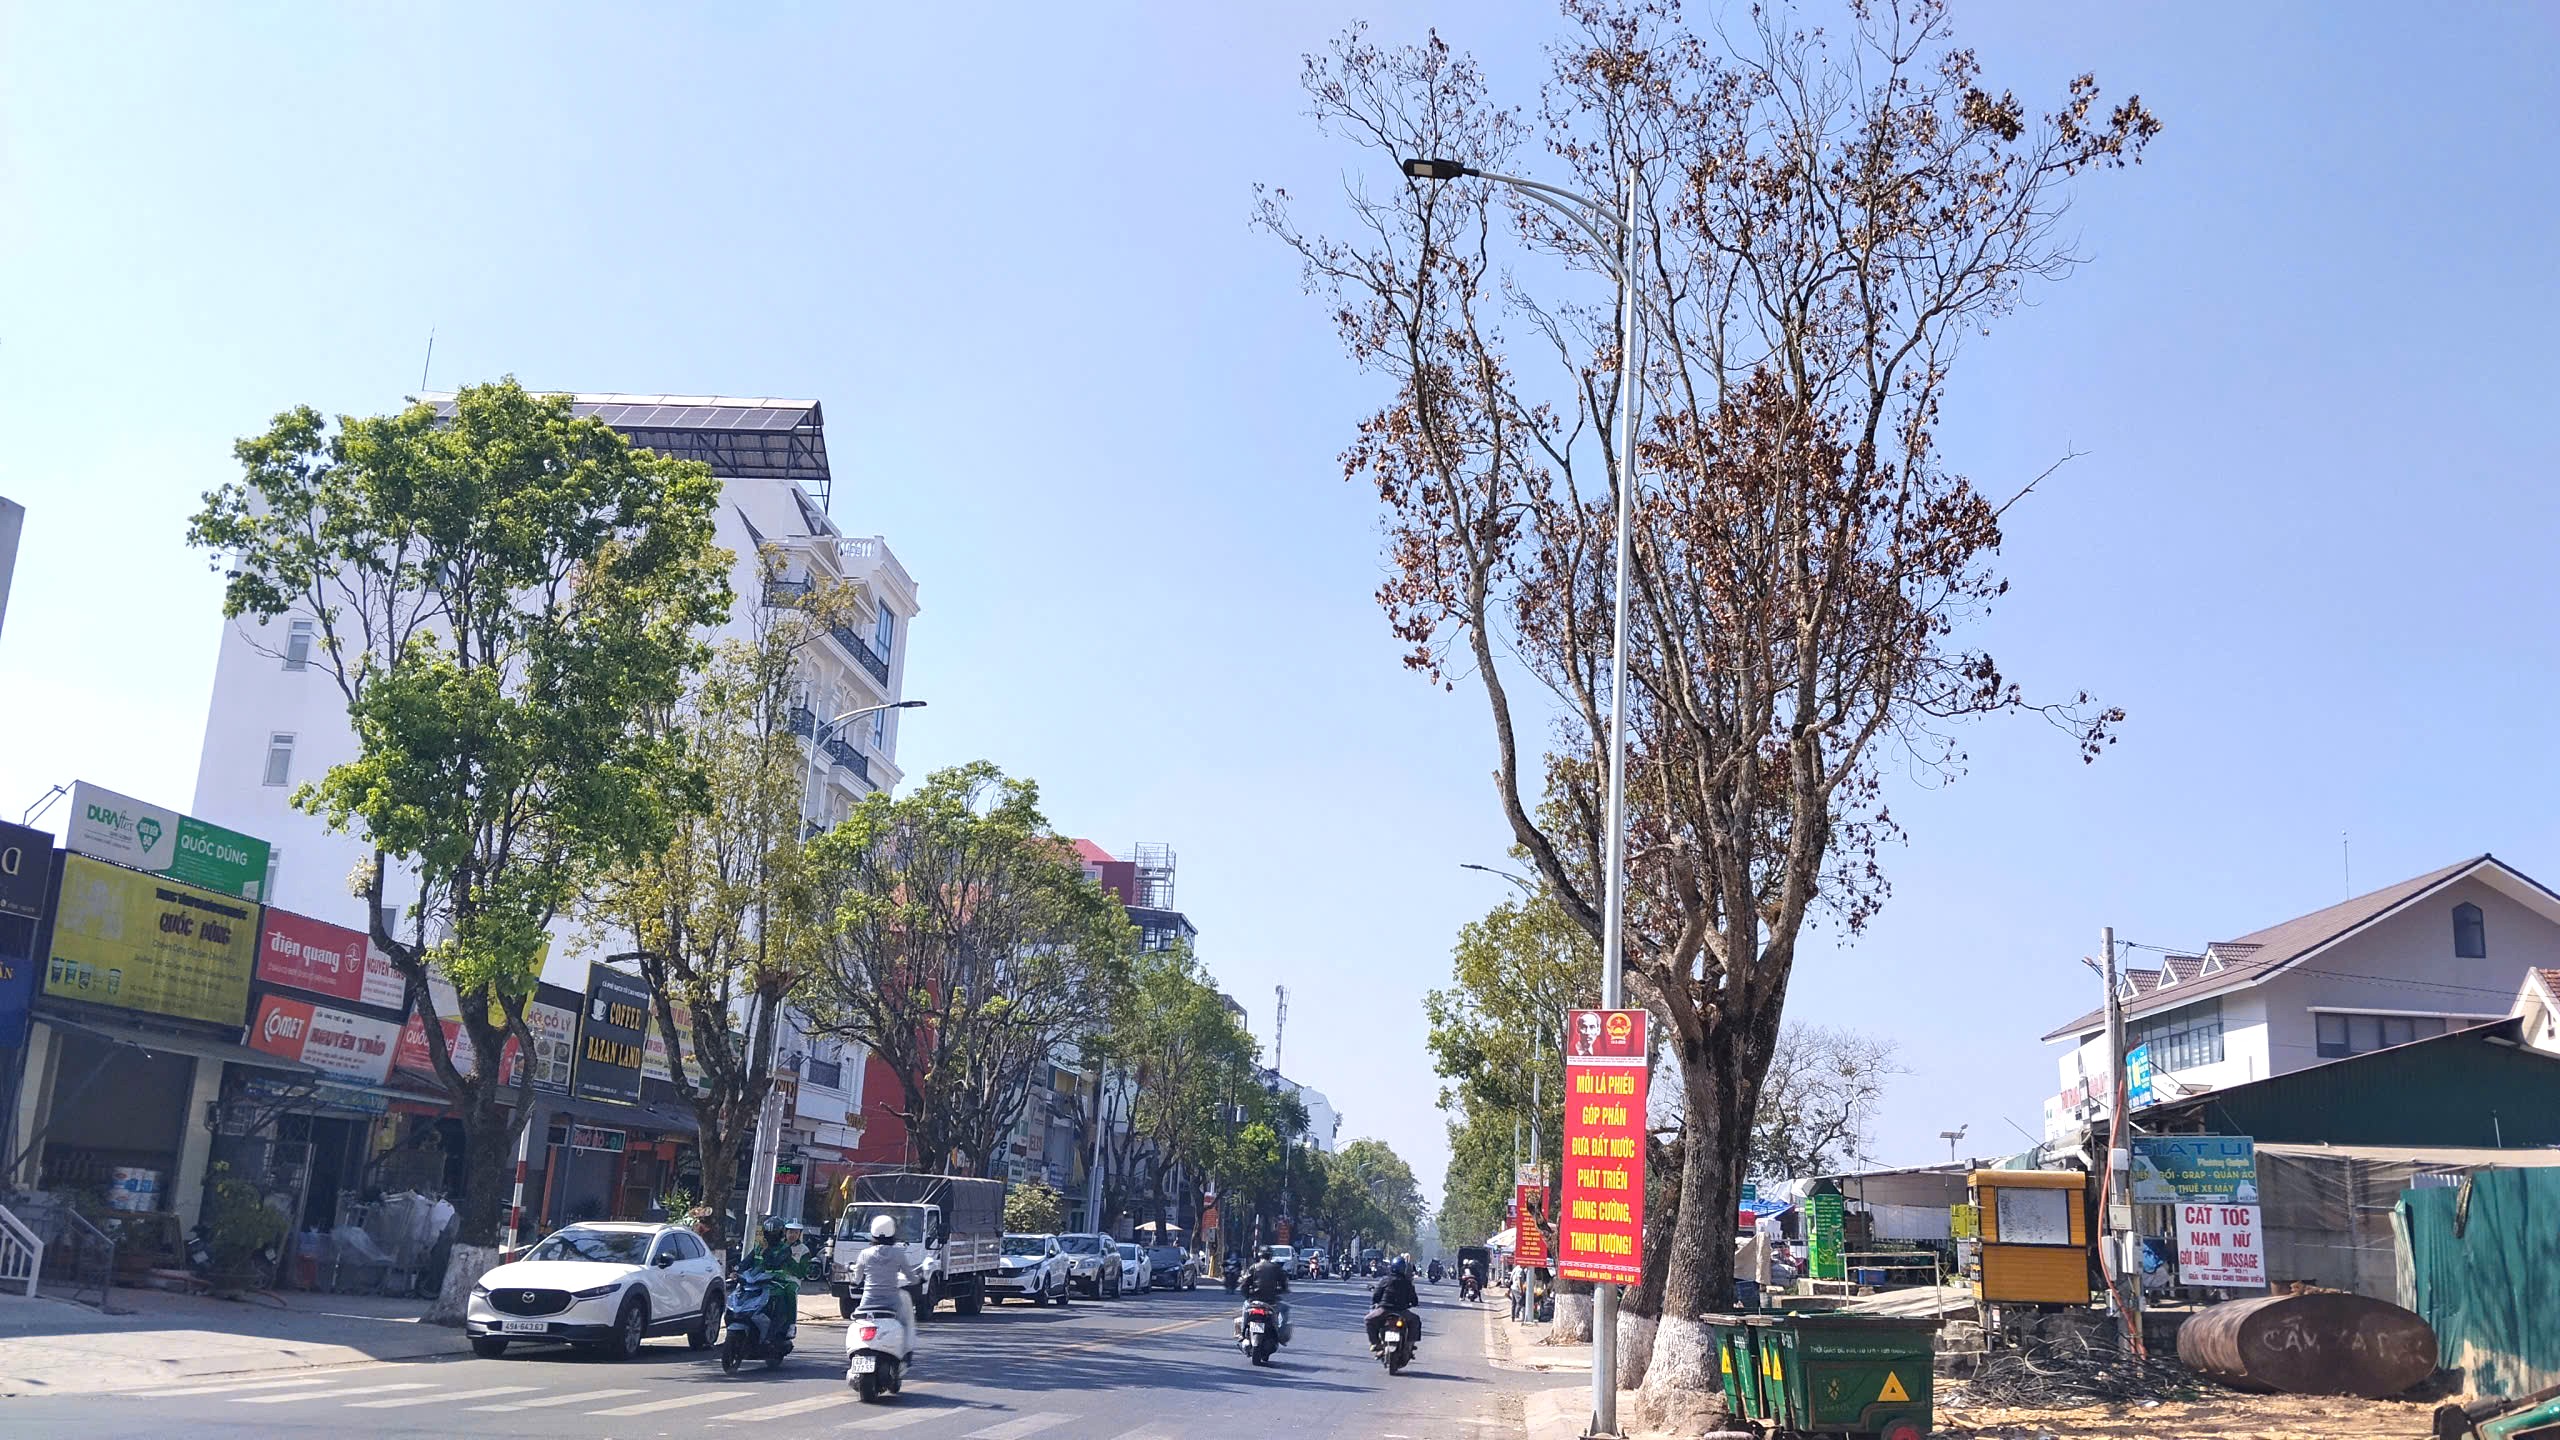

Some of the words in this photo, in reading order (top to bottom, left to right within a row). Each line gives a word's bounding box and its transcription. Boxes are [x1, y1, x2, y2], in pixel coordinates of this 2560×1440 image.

[181, 835, 214, 857] QUỐC
[268, 931, 300, 957] điện
[302, 945, 341, 973] quang
[264, 1007, 305, 1042] COMET
[609, 1001, 642, 1031] COFFEE
[586, 1035, 618, 1065] BAZAN
[617, 1043, 642, 1069] LAND
[1595, 1072, 1607, 1094] LÁ
[1608, 1070, 1635, 1095] PHIẾU
[1582, 1103, 1601, 1125] GÓP
[1571, 1135, 1590, 1156] ĐƯA
[1591, 1132, 1609, 1157] ĐẤT
[1610, 1135, 1635, 1159] NƯỚC
[1577, 1165, 1601, 1188] PHÁT
[1602, 1163, 1628, 1190] TRIỂN
[2182, 1171, 2206, 1179] GRAP
[2178, 1184, 2199, 1193] THUÊ
[2201, 1185, 2212, 1193] XE
[2214, 1184, 2234, 1193] MÁY
[1572, 1196, 1597, 1220] HÙNG
[2185, 1203, 2213, 1225] CẮT
[2220, 1206, 2250, 1226] TÓC
[1570, 1231, 1597, 1256] THỊNH
[1598, 1233, 1632, 1258] VƯỢNG!
[2191, 1231, 2221, 1247] NAM
[2233, 1230, 2251, 1248] NỮ
[2221, 1253, 2258, 1269] MASSAGE
